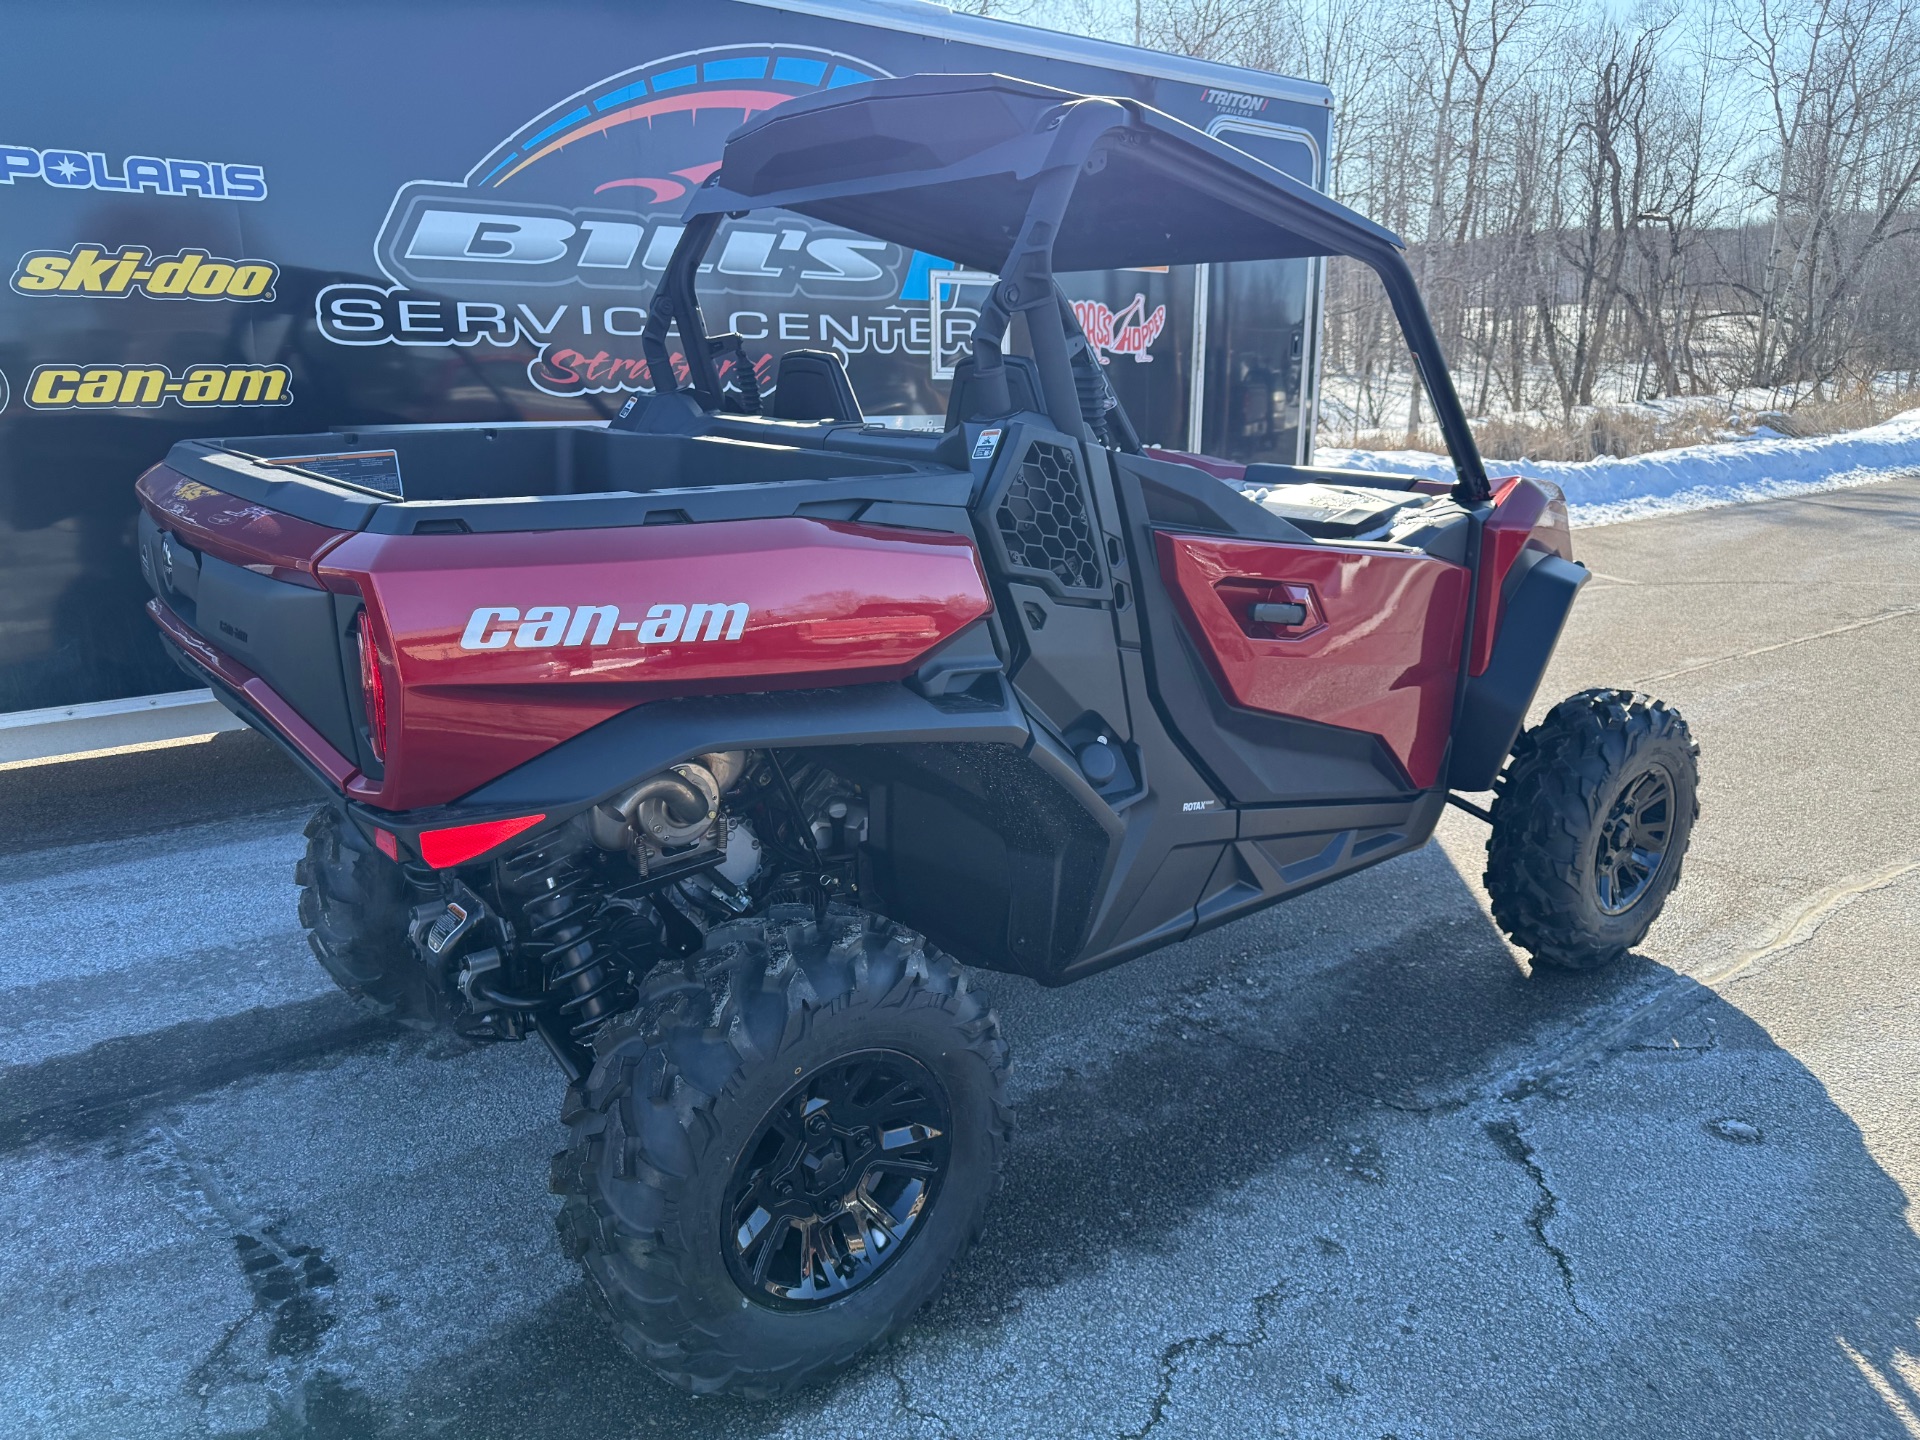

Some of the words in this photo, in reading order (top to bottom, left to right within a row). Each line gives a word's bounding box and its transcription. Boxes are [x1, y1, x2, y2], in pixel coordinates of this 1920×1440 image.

[1207, 89, 1264, 111] TRITON
[1216, 105, 1253, 117] TRAILERS
[0, 145, 267, 200] POLARIS
[330, 298, 681, 337] SERVIC
[729, 310, 977, 344] CENTER
[1114, 306, 1164, 351] HOPPER
[32, 370, 287, 403] can-am
[460, 602, 750, 650] can-am
[1182, 801, 1206, 812] ROTAX
